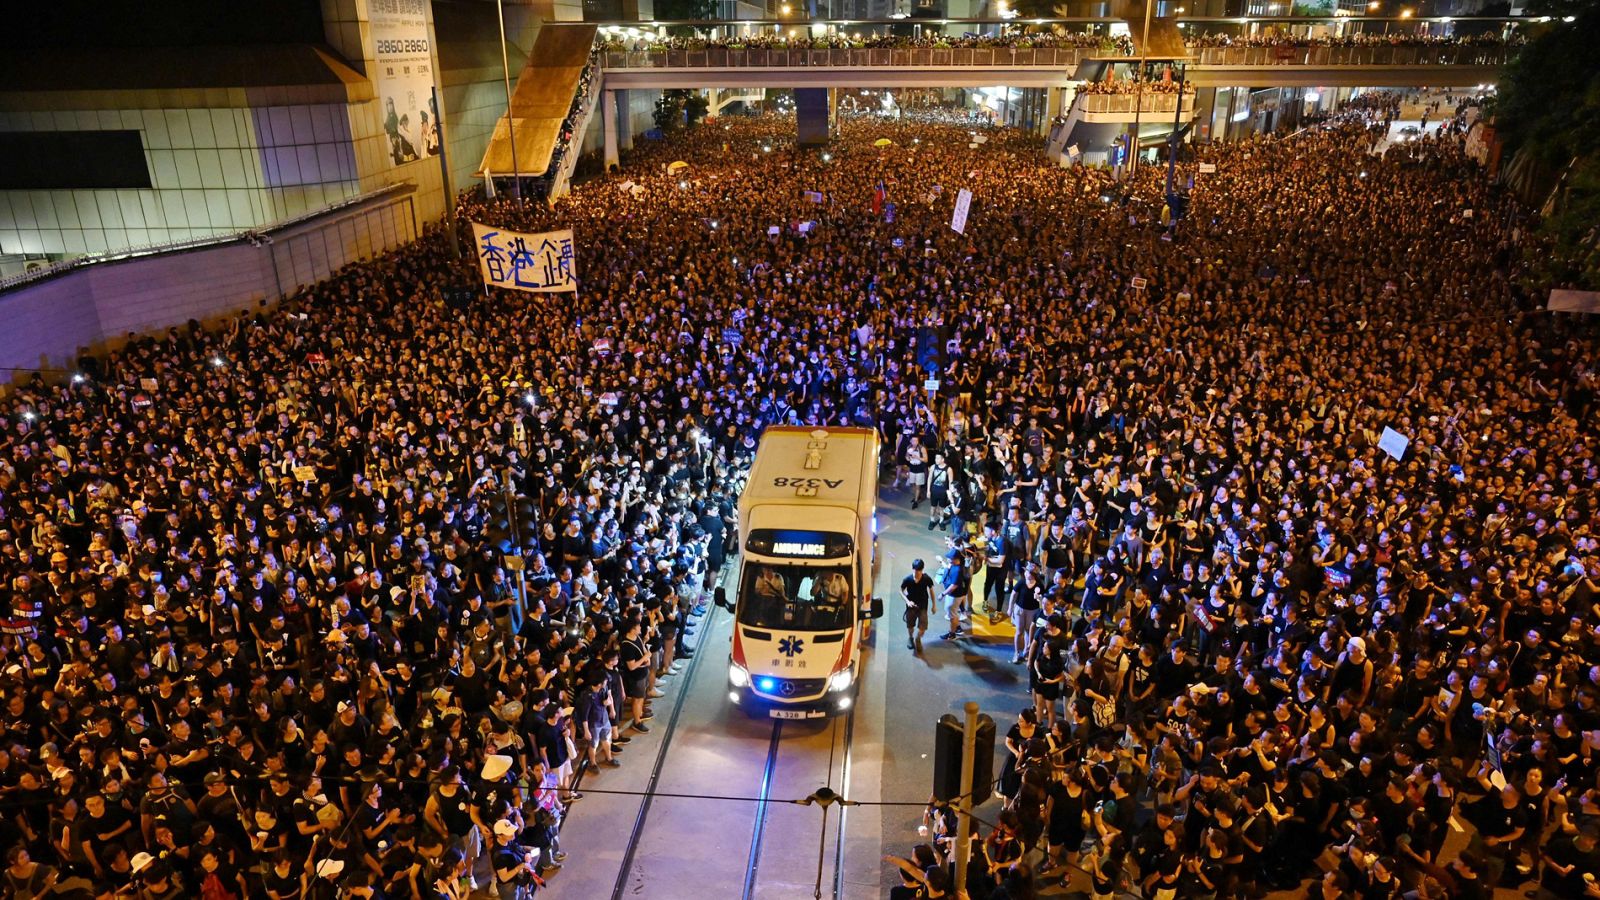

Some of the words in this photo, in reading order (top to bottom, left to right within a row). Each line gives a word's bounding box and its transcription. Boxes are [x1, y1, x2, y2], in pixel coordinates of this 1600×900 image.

[377, 40, 403, 54] 2860
[404, 40, 428, 53] 2860
[774, 477, 844, 488] A328
[773, 543, 825, 555] AMBULANCE
